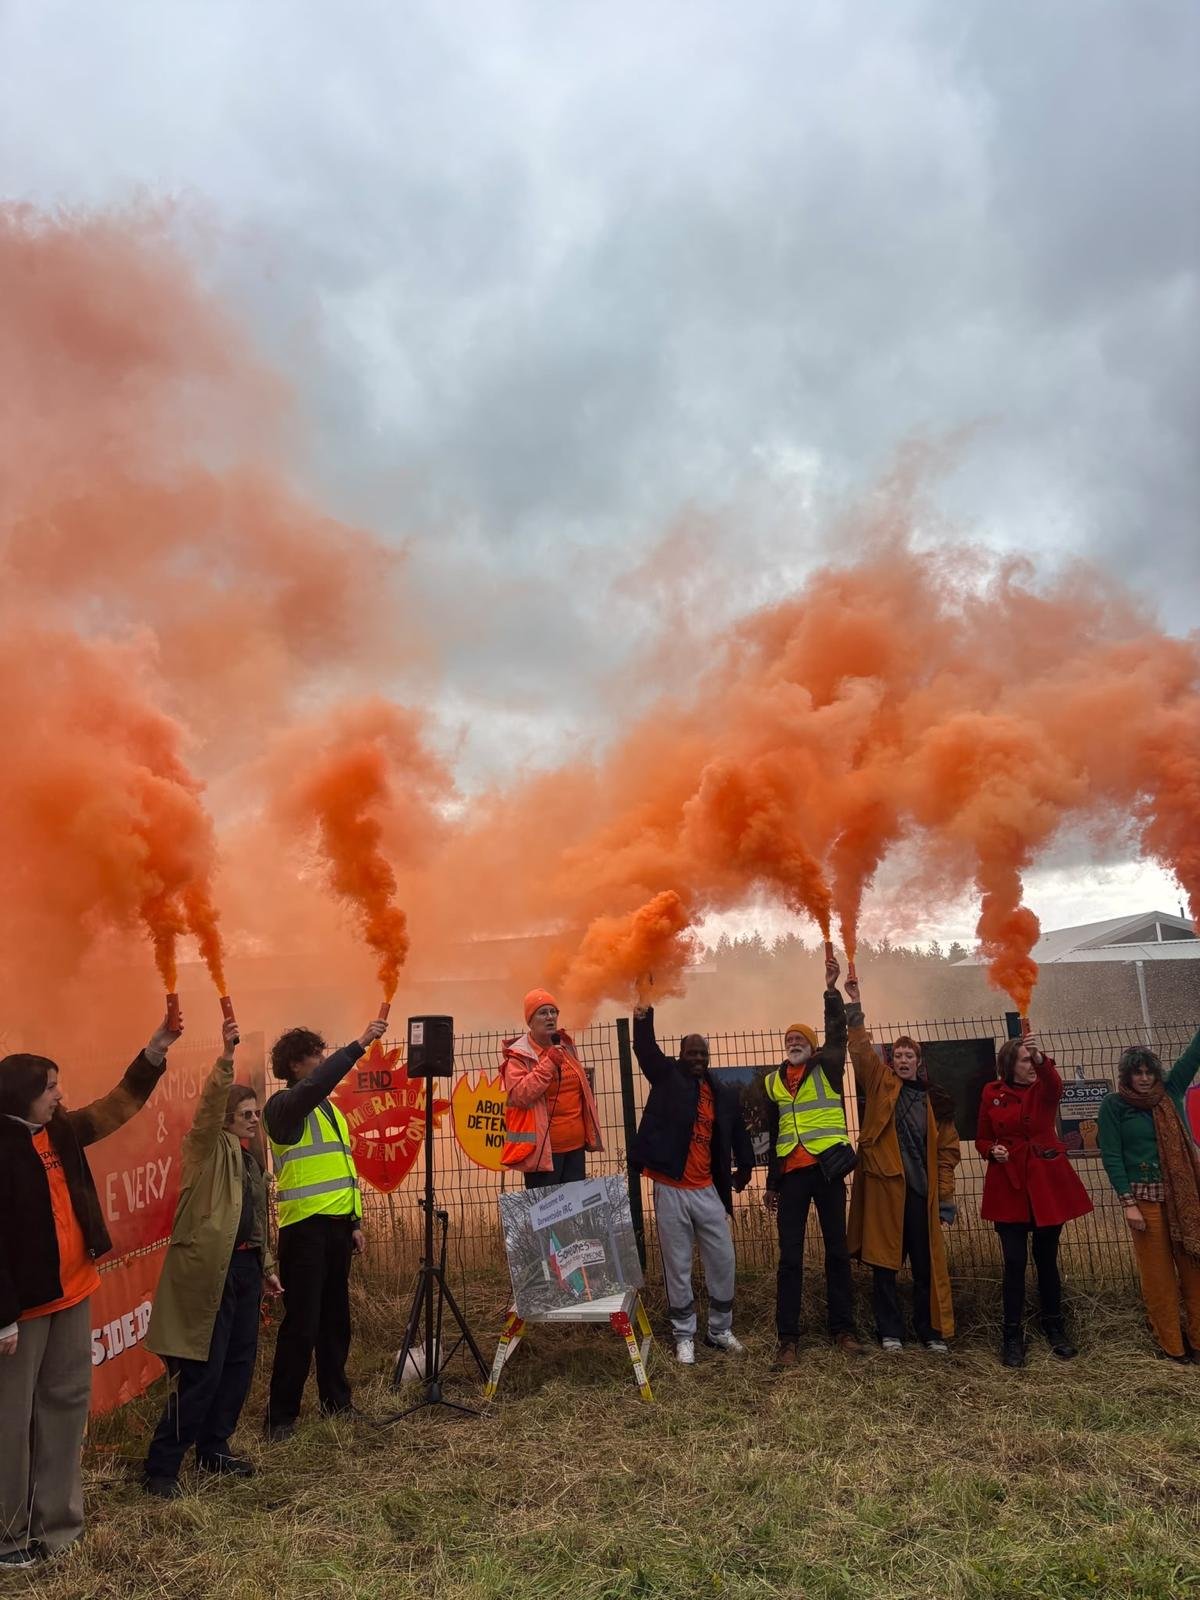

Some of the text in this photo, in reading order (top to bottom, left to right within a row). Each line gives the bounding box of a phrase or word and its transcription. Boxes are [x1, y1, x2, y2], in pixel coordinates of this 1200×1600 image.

[357, 1070, 393, 1090] END
[1076, 1088, 1108, 1097] STOP
[157, 1112, 168, 1144] &
[106, 1156, 172, 1222] EVERY
